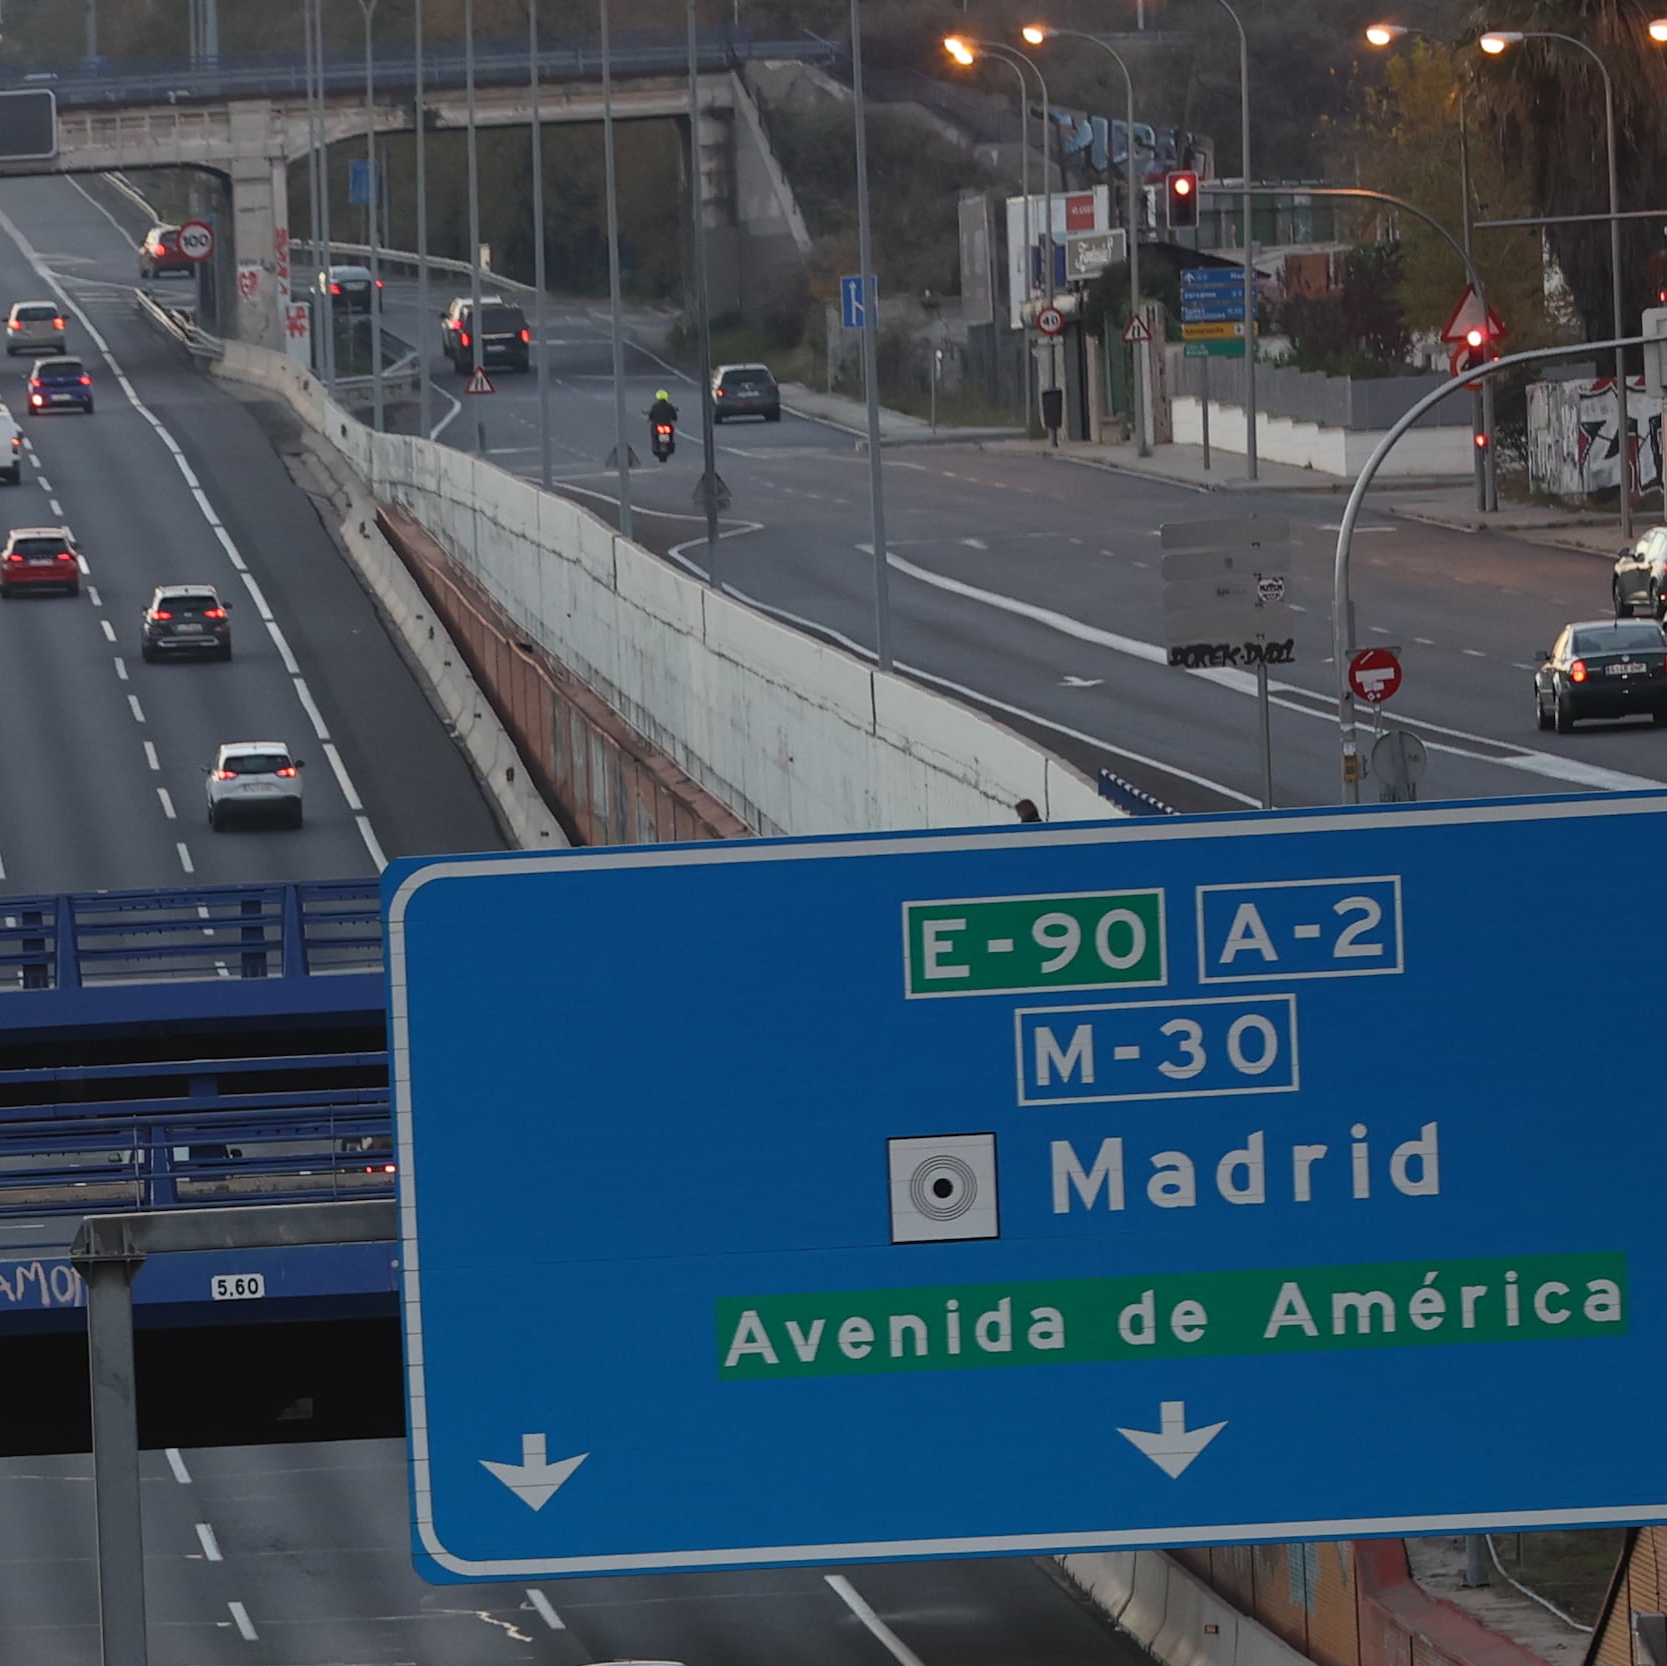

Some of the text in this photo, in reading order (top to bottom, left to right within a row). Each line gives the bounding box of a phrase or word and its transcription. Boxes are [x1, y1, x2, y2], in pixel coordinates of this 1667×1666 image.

[183, 234, 209, 247] 100
[1042, 315, 1058, 326] 40
[922, 895, 1386, 979] E-90 A-2
[1033, 1011, 1281, 1087] M-30
[1052, 1121, 1442, 1214] Madrid
[724, 1271, 1623, 1370] Avenida de América
